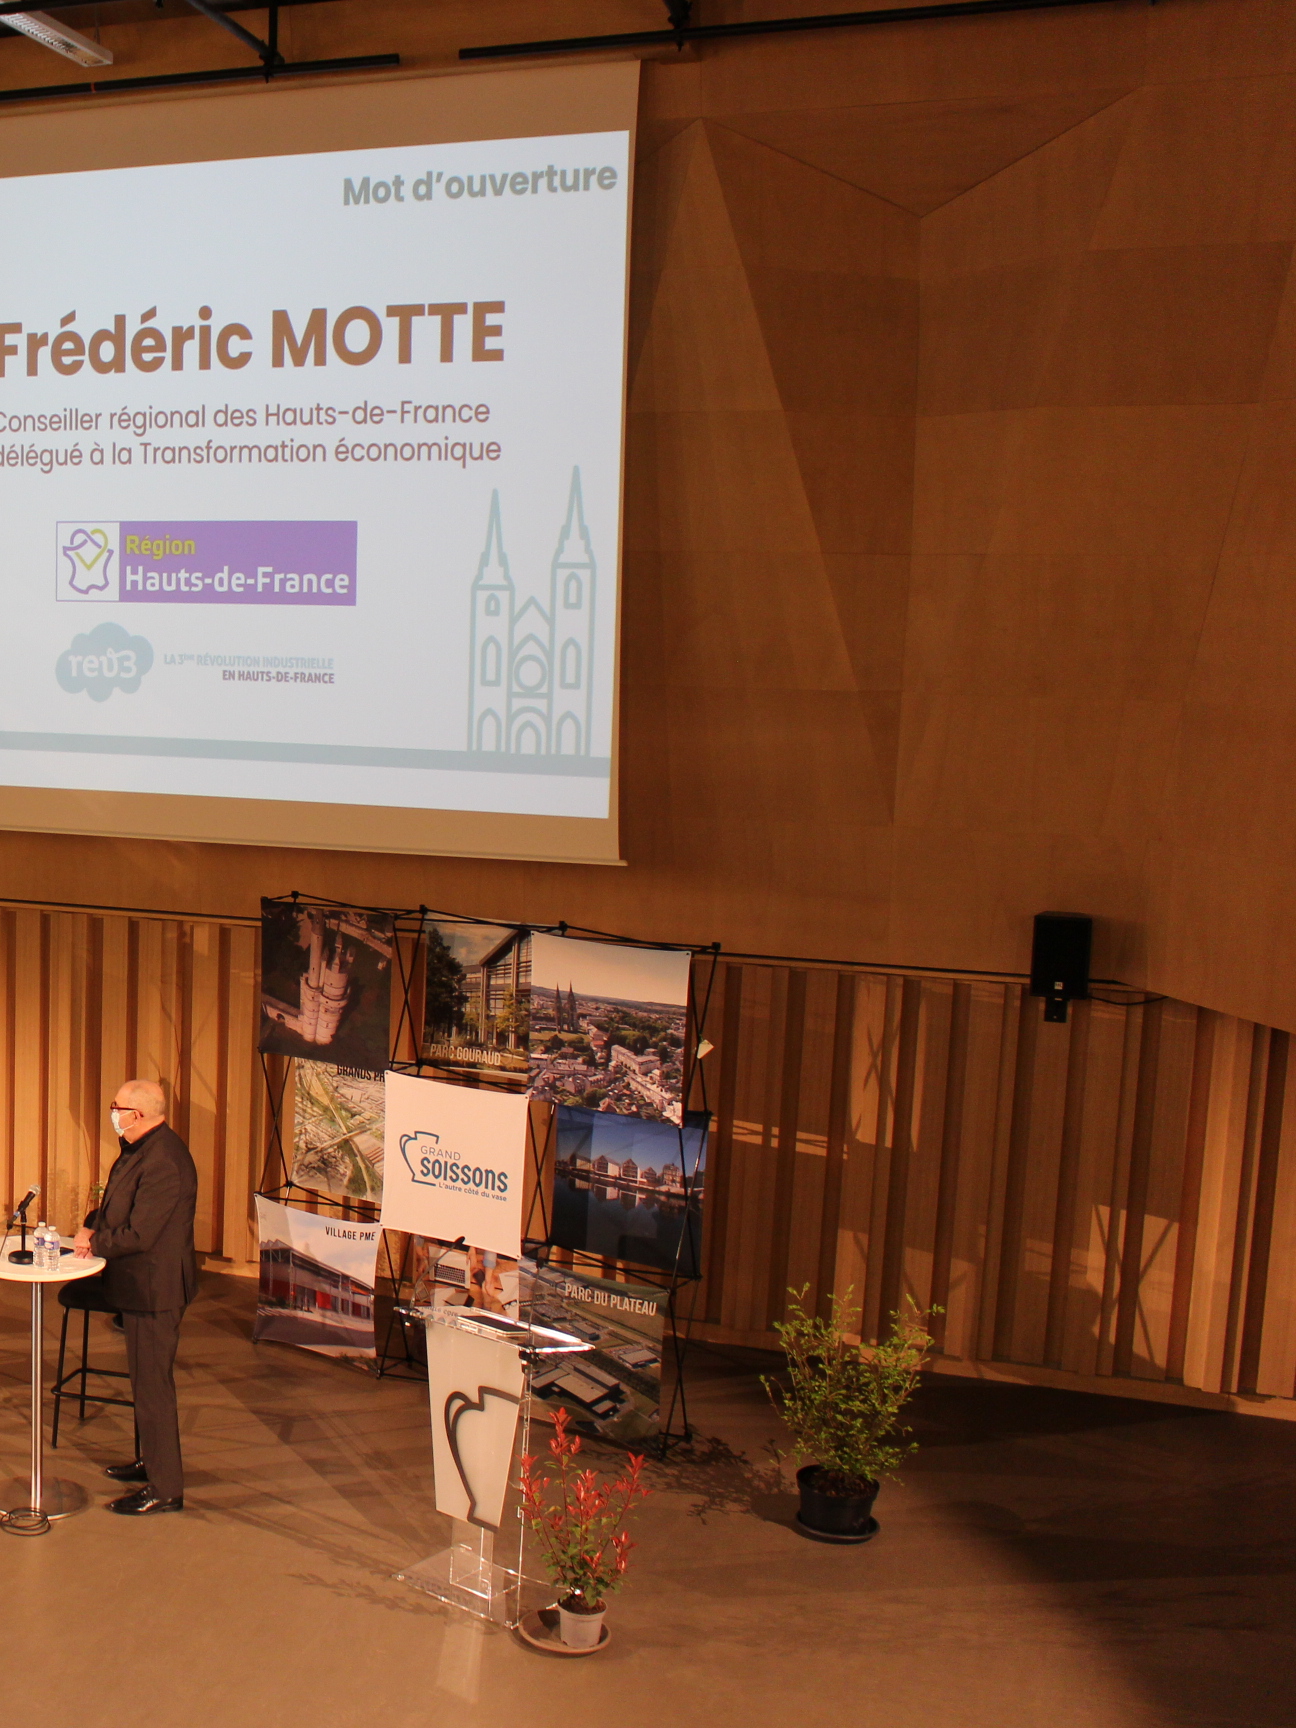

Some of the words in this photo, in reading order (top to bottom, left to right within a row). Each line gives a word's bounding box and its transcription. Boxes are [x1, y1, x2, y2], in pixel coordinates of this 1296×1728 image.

[343, 175, 404, 206] Mot
[412, 164, 618, 202] d'ouverture
[271, 301, 506, 369] MOTTE
[109, 404, 206, 437] régional
[213, 403, 258, 428] des
[265, 400, 491, 427] Hauts-de-France
[89, 442, 105, 466] à
[112, 442, 133, 466] la
[140, 437, 327, 465] Transformation
[334, 436, 502, 470] économique
[125, 535, 196, 560] Région
[125, 565, 350, 594] Hauts-de-France
[164, 653, 176, 665] LA
[196, 652, 261, 668] RÉVOLUTION
[262, 655, 334, 669] INDUSTRIELLE
[222, 670, 236, 681] EN
[238, 670, 335, 684] HAUTS-DE-FRANCE
[430, 1044, 455, 1059] PARC
[456, 1046, 501, 1066] GOURAUD
[337, 1064, 371, 1081] GRANDS
[420, 1145, 461, 1161] GRAND
[438, 1181, 462, 1192] L'autre
[464, 1187, 479, 1196] côté
[480, 1190, 490, 1198] du
[491, 1193, 507, 1202] vase
[325, 1226, 357, 1241] VILLAGE
[359, 1231, 376, 1241] PME
[564, 1283, 592, 1302] PARC
[593, 1290, 608, 1307] DU
[610, 1294, 657, 1317] PLATEAU
